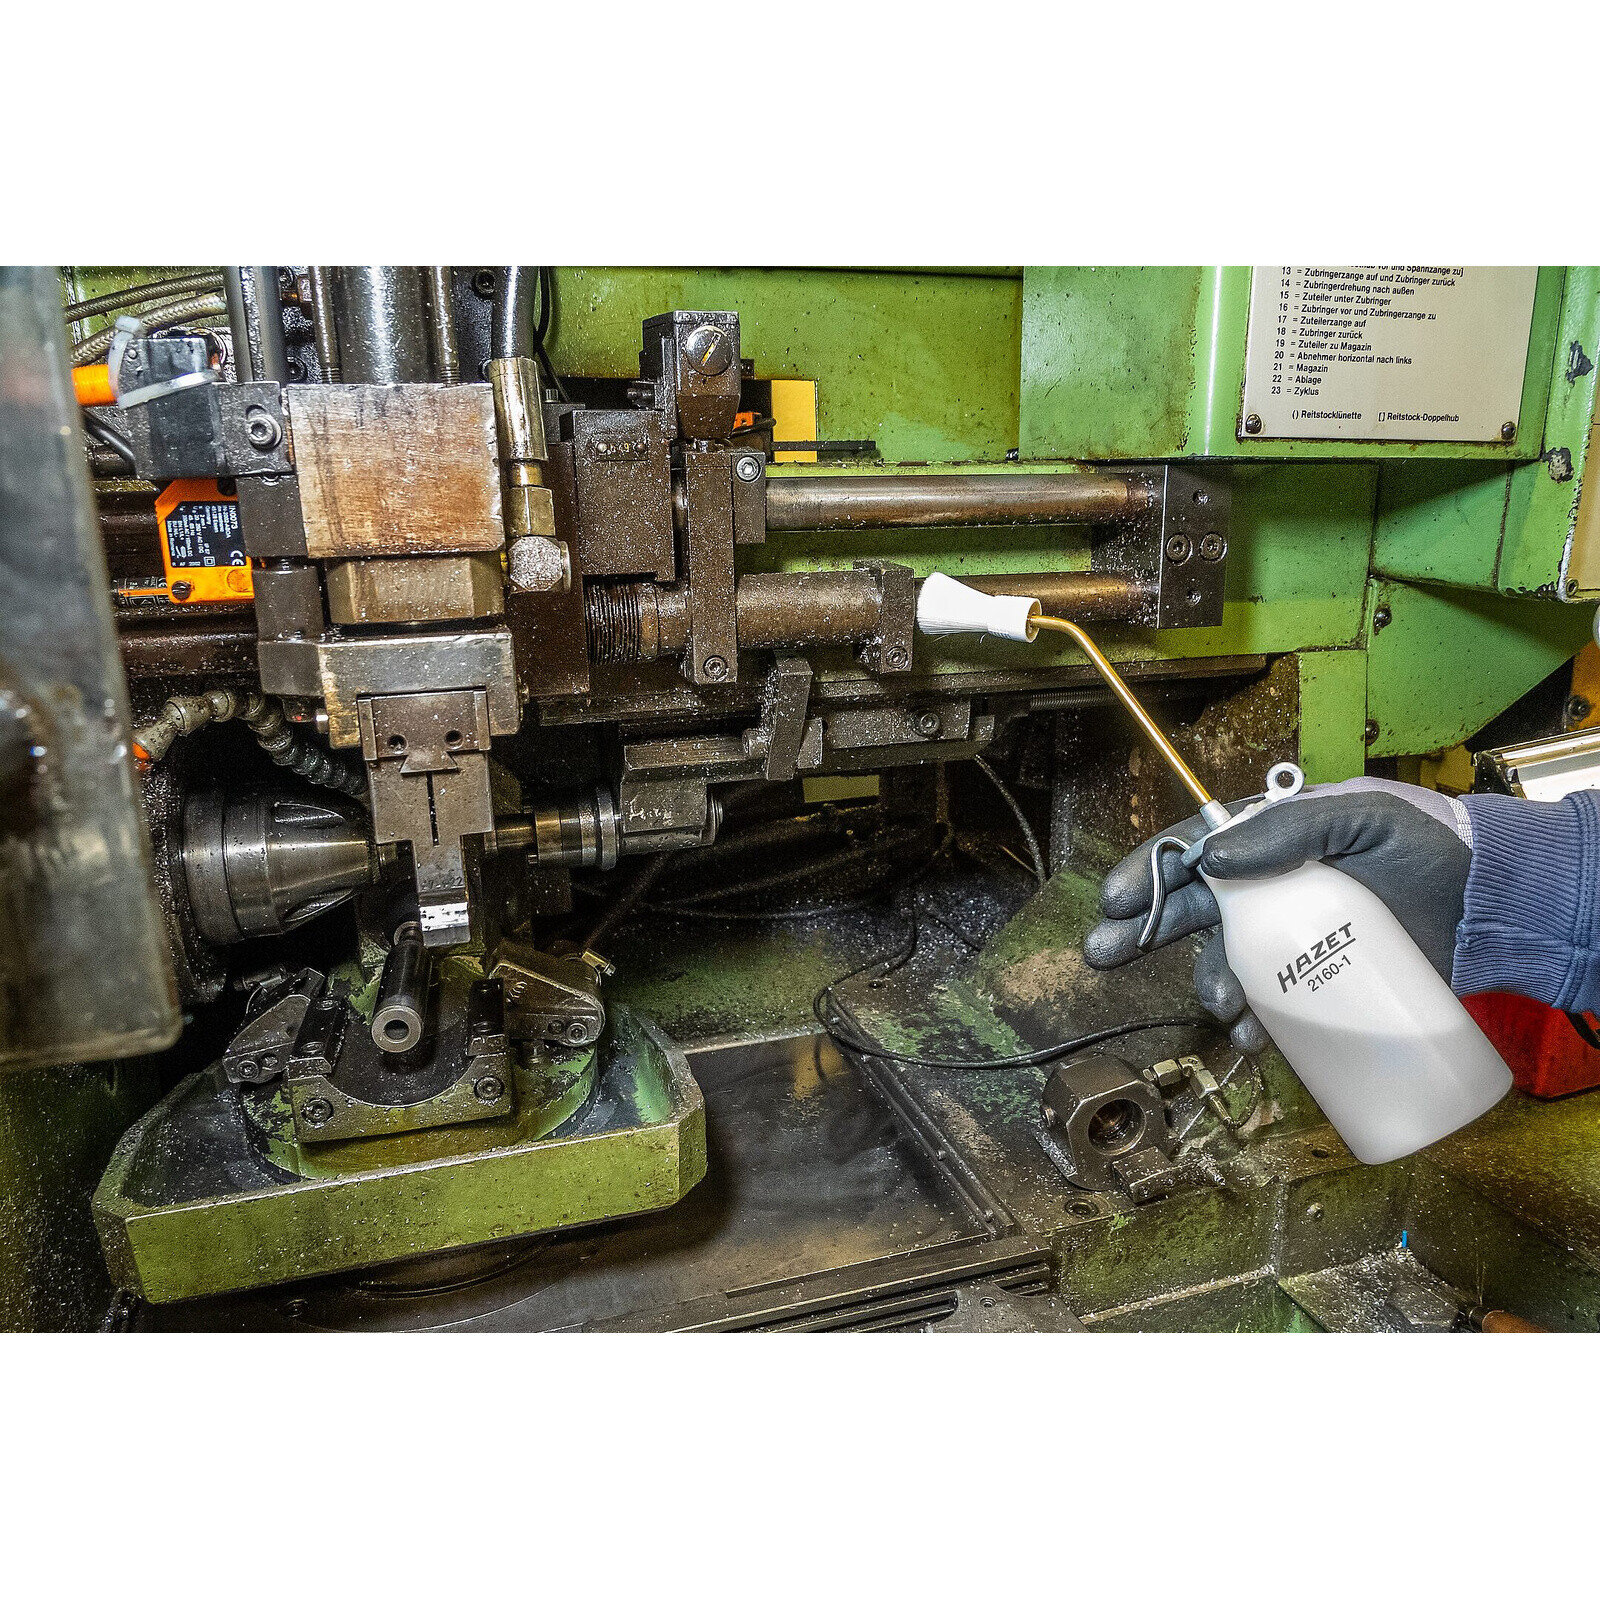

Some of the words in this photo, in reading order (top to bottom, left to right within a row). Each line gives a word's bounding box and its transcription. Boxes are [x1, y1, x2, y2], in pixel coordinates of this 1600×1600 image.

[1282, 266, 1291, 275] 13
[1304, 268, 1364, 281] Zubringerzange
[1380, 274, 1393, 282] und
[1395, 275, 1430, 286] Zubringer
[1432, 278, 1455, 286] zurück
[1406, 266, 1450, 276] Spannzange
[1281, 279, 1290, 287] 14
[1304, 280, 1370, 294] Zubringerdrehung
[1392, 287, 1414, 295] außen
[1280, 291, 1289, 299] 15
[1302, 292, 1332, 302] Zuteiler
[1356, 296, 1391, 306] Zubringer
[1279, 303, 1288, 311] 16
[1301, 304, 1338, 315] Zubringer
[1370, 308, 1426, 320] Zubringerzange
[1278, 315, 1287, 323] 17
[1300, 316, 1352, 328] Zuteilerzange
[1277, 327, 1286, 335] 18
[1299, 328, 1336, 339] Zubringer
[1338, 330, 1363, 339] zurück
[1276, 339, 1285, 347] 19
[1298, 340, 1328, 349] Zuteiler
[1340, 342, 1372, 352] Magazin
[1274, 351, 1284, 359] 20
[1297, 352, 1336, 361] Abnehmer
[1338, 353, 1374, 362] horizontal
[1396, 356, 1412, 364] links
[1296, 364, 1328, 373] Magazin
[1295, 375, 1322, 385] Ablage
[1272, 386, 1281, 394] 23
[1294, 387, 1319, 396] Zyklus
[1301, 410, 1362, 420] Reitstocklünette
[1387, 412, 1460, 422] Reitstock-Doppelhub
[229, 505, 238, 529] IN0073
[1277, 922, 1351, 994] HAZET
[1308, 955, 1351, 992] 2160-1
